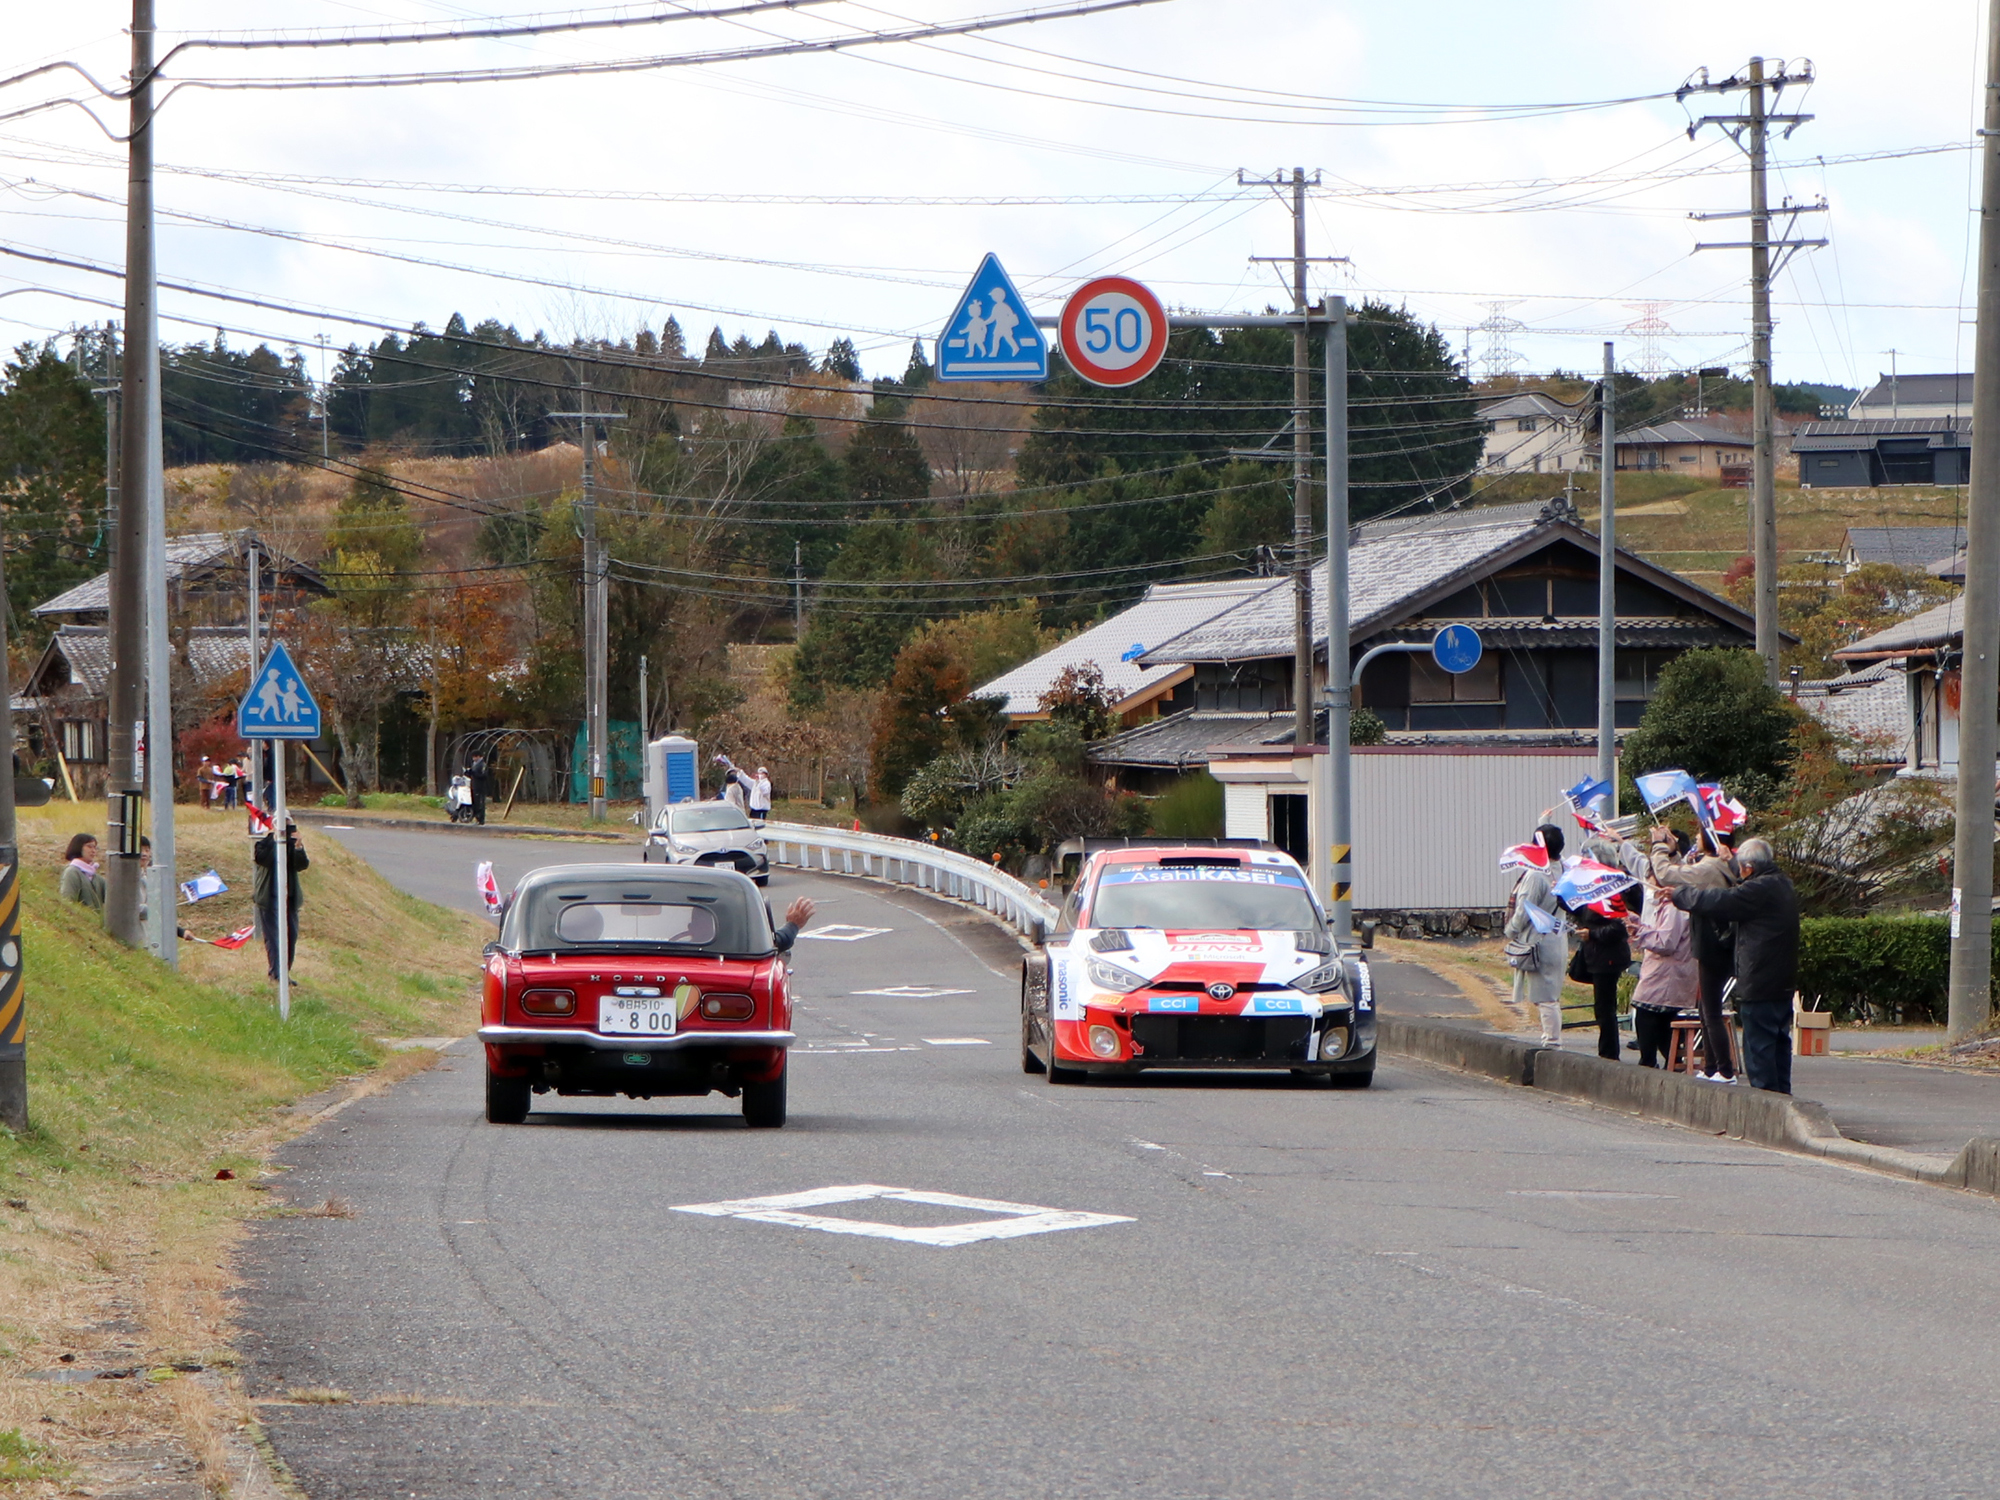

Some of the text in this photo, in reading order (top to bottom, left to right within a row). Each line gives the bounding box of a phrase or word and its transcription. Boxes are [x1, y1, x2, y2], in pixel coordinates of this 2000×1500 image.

[1085, 307, 1142, 354] 50
[1243, 866, 1283, 875] Racing
[1170, 944, 1264, 953] DENSO
[590, 974, 689, 983] HONDA
[1160, 999, 1187, 1009] CCI
[1265, 1000, 1291, 1010] CCI
